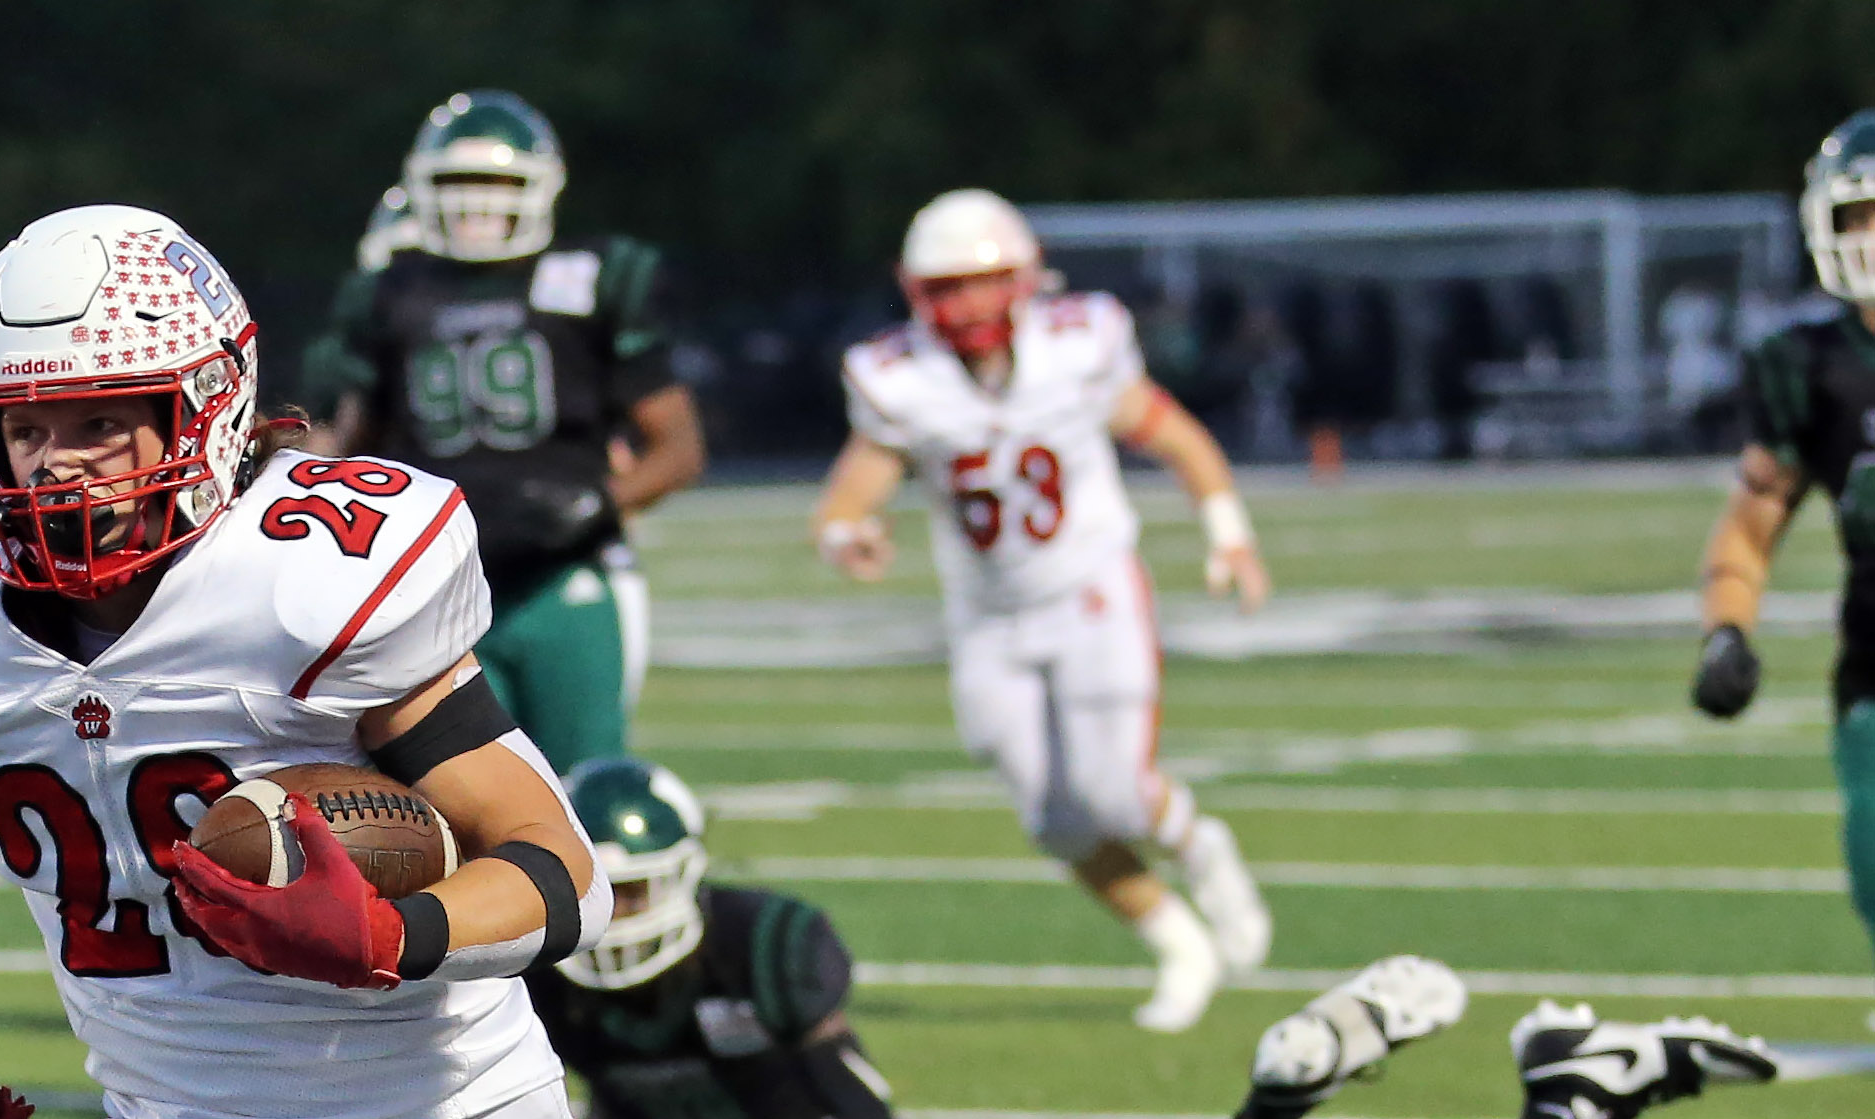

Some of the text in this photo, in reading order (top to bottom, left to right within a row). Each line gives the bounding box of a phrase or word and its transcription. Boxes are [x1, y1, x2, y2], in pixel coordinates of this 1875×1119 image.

[2, 358, 74, 375] Riddell
[405, 330, 556, 458] 99
[260, 459, 412, 559] 28
[950, 446, 1065, 551] 53
[84, 721, 102, 734] W
